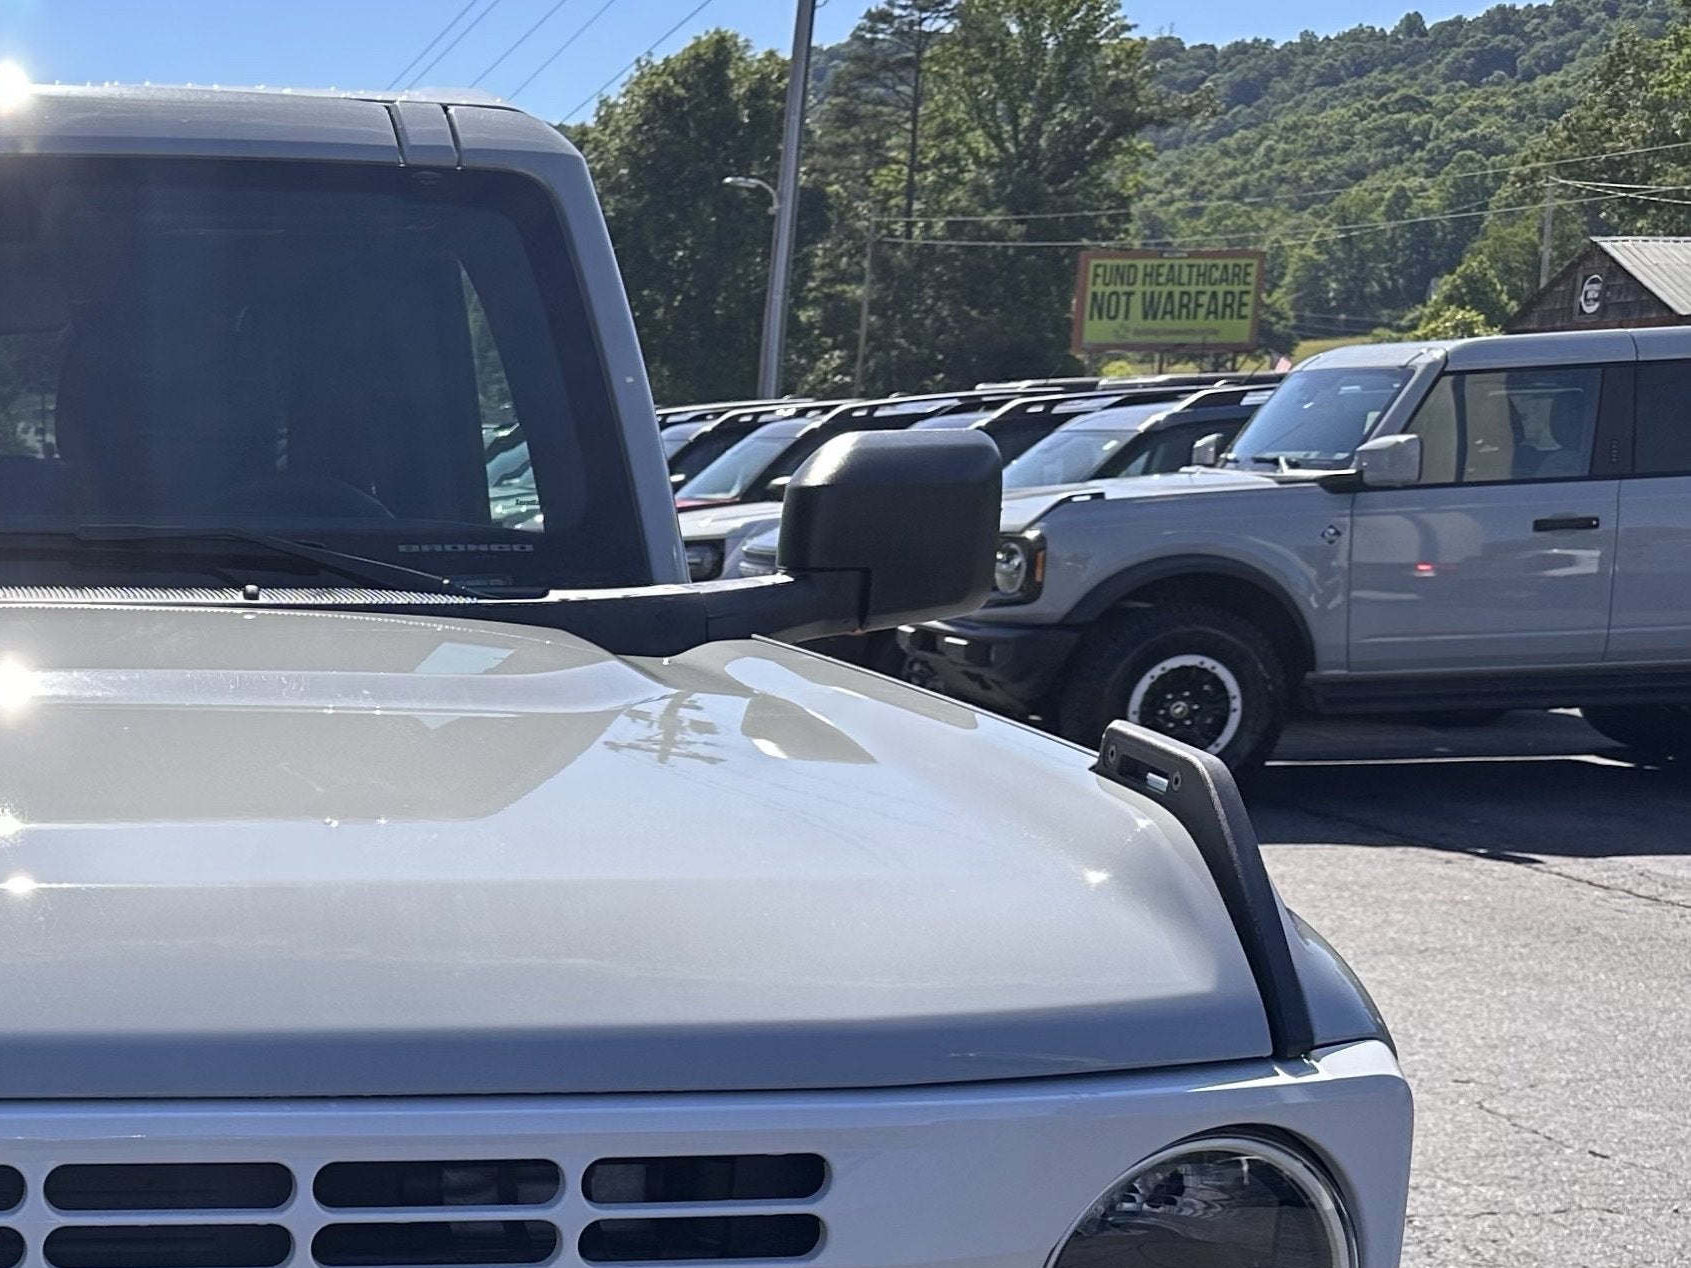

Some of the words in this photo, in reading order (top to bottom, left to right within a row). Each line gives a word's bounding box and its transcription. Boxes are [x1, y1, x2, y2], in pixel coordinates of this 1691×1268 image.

[1092, 263, 1138, 287] FUND
[1142, 263, 1254, 287] HEALTHCARE
[1088, 290, 1135, 321] NOT
[1141, 290, 1251, 321] WARFARE
